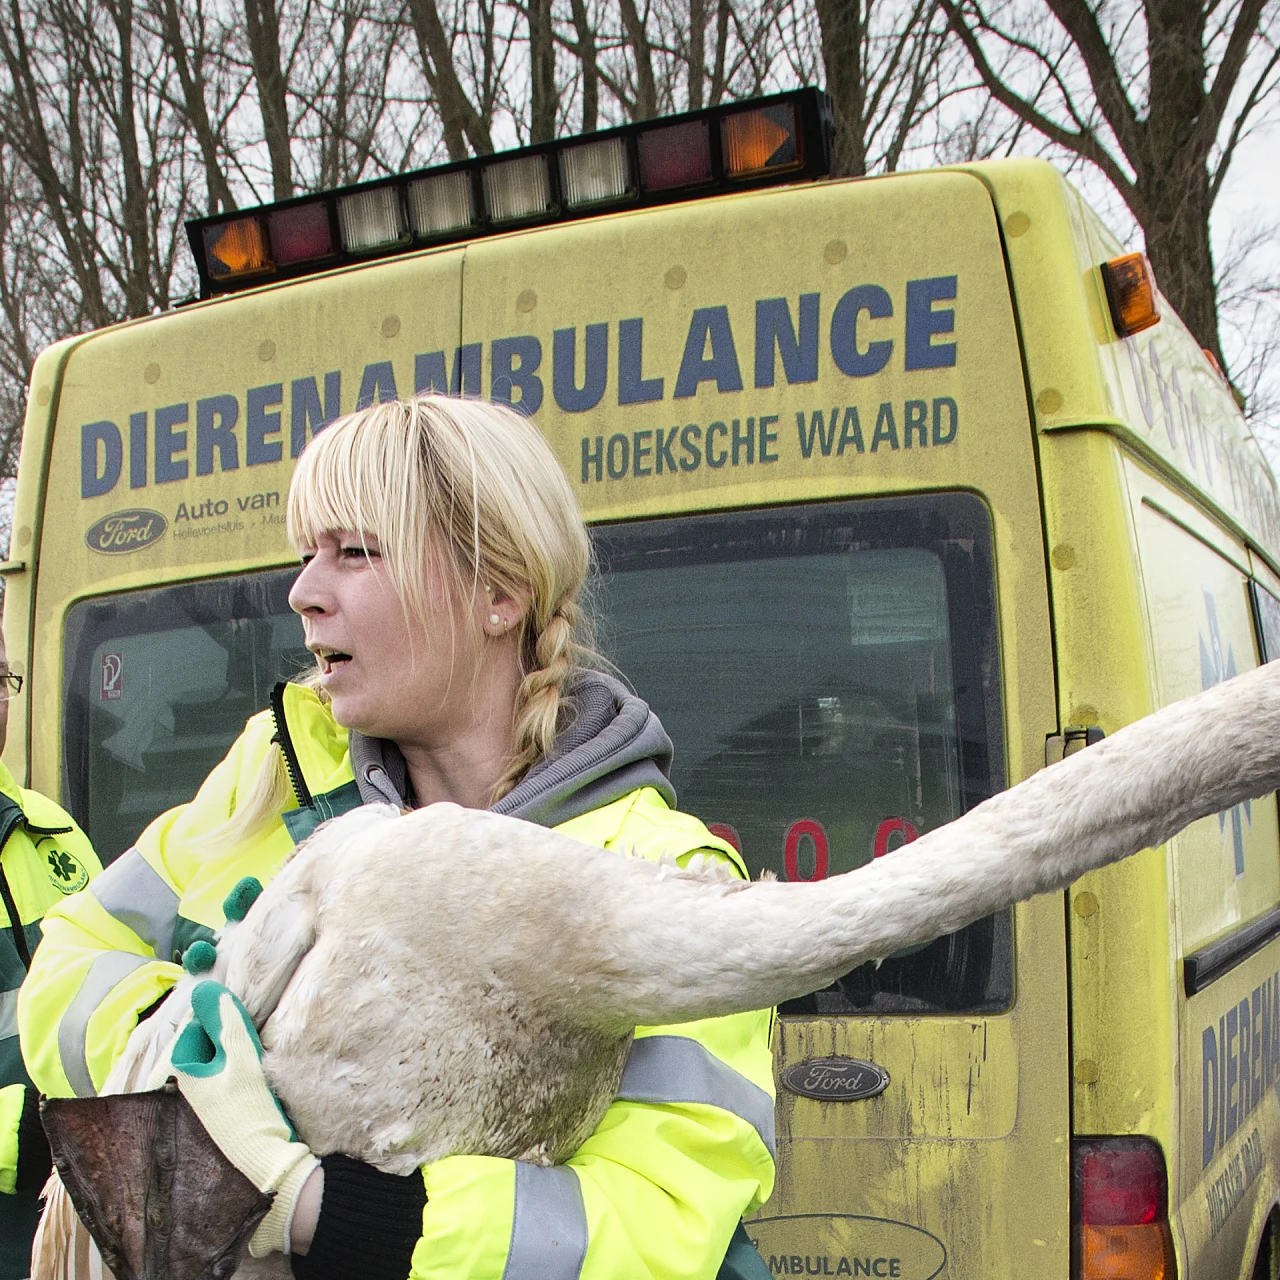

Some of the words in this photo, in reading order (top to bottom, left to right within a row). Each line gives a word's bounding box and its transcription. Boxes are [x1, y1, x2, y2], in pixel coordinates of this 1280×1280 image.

[582, 415, 779, 484] HOEKSCHE
[797, 397, 959, 458] WAARD
[174, 499, 229, 523] Auto
[237, 490, 280, 511] van
[804, 1065, 863, 1090] Ford
[769, 1255, 901, 1278] MBULANCE
